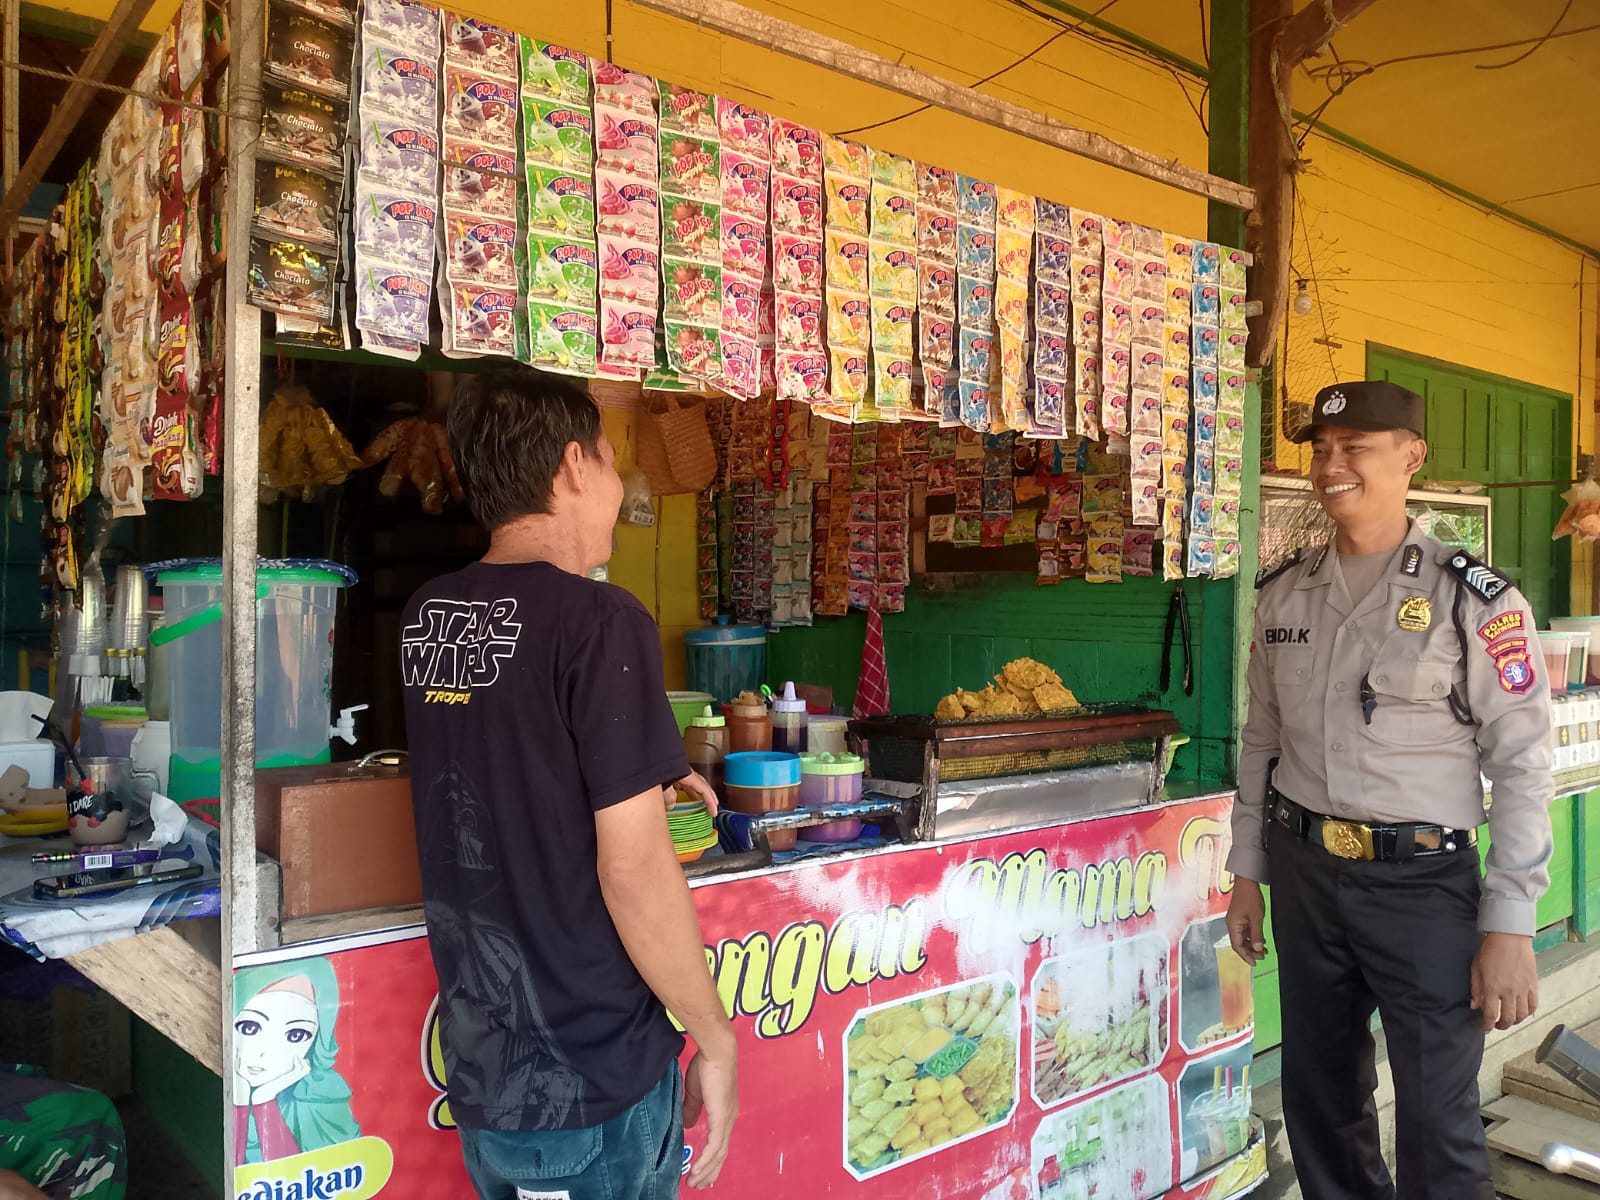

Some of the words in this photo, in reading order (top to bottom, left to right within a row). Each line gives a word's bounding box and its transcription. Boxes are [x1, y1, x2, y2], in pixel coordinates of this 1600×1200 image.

[549, 45, 567, 56] POP
[395, 60, 416, 73] POP
[476, 84, 497, 97] POP
[674, 93, 693, 112] POP
[551, 111, 571, 123] POP
[393, 131, 416, 145] POP
[475, 155, 496, 168] POP
[674, 154, 693, 176] POP
[555, 177, 574, 191] POP
[624, 185, 641, 197] POP
[391, 202, 414, 217] POP
[477, 225, 497, 239] POP
[676, 218, 695, 238] POP
[557, 245, 575, 258] POP
[386, 276, 408, 292] POP
[409, 278, 428, 296] ICE
[677, 282, 696, 302] POP
[482, 294, 504, 307] POP
[402, 598, 522, 644] STAR
[1483, 613, 1522, 638] POLRES
[401, 641, 515, 688] WARS
[73, 795, 95, 812] DARE
[702, 899, 927, 1040] ngan
